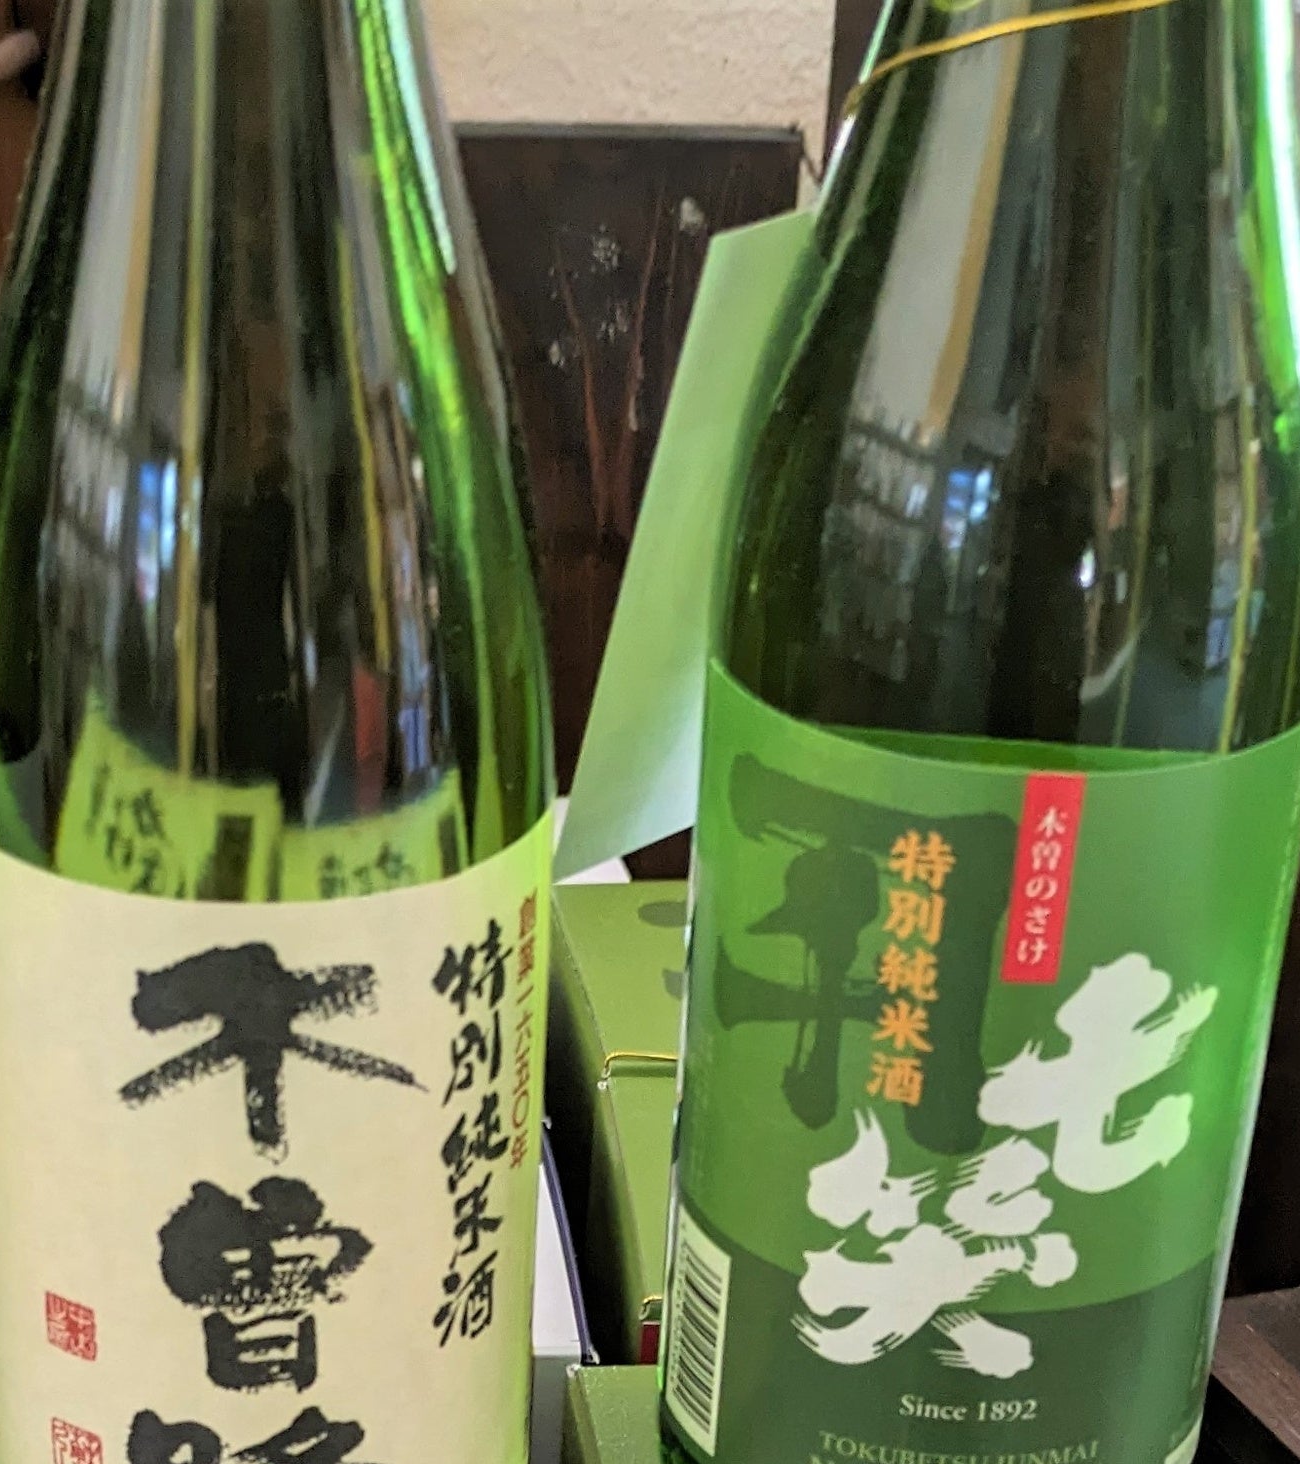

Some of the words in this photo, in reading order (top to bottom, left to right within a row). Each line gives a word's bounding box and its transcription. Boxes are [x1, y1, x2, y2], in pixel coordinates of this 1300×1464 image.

[865, 829, 956, 1108] 特別純米酒
[1016, 805, 1069, 966] 木曽のさけ
[432, 918, 513, 1349] 特別純米酒
[899, 1393, 968, 1421] Since
[977, 1398, 1038, 1422] 1892
